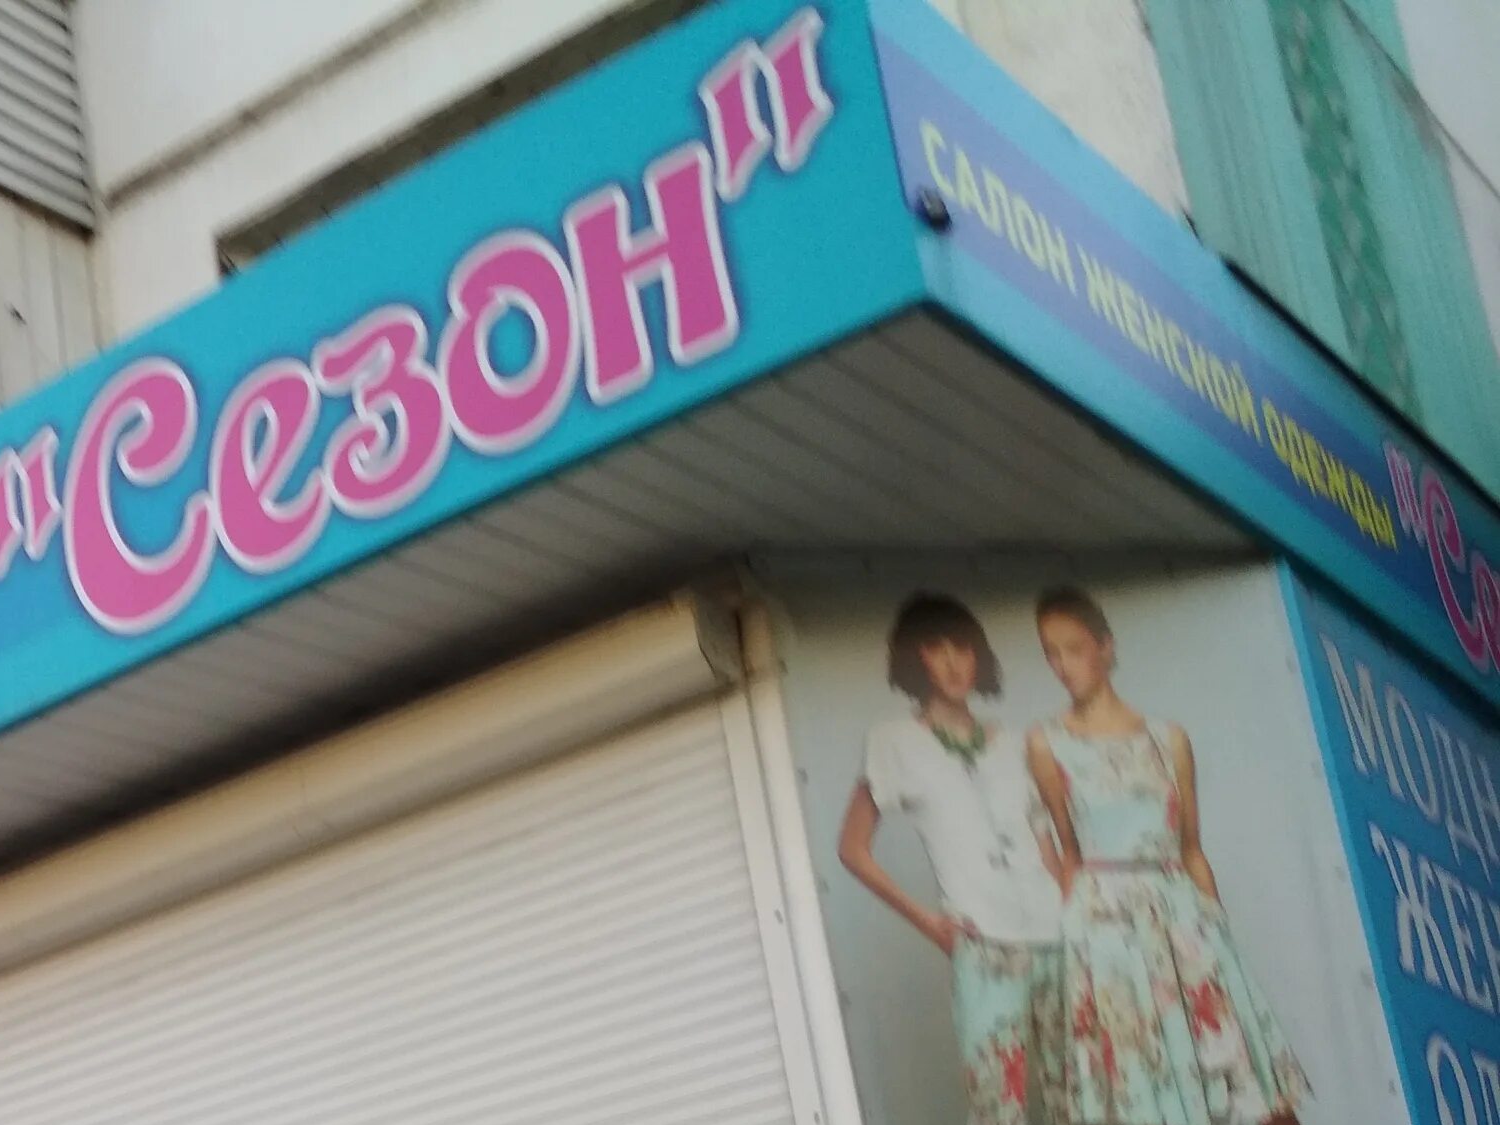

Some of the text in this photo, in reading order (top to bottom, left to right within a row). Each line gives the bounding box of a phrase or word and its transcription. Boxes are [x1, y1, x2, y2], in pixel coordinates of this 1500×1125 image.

[918, 116, 1078, 297] САЛОН
[1076, 243, 1264, 447] ЖЕНСКОЙ
[1261, 396, 1398, 552] ОДЕЖДЫ
